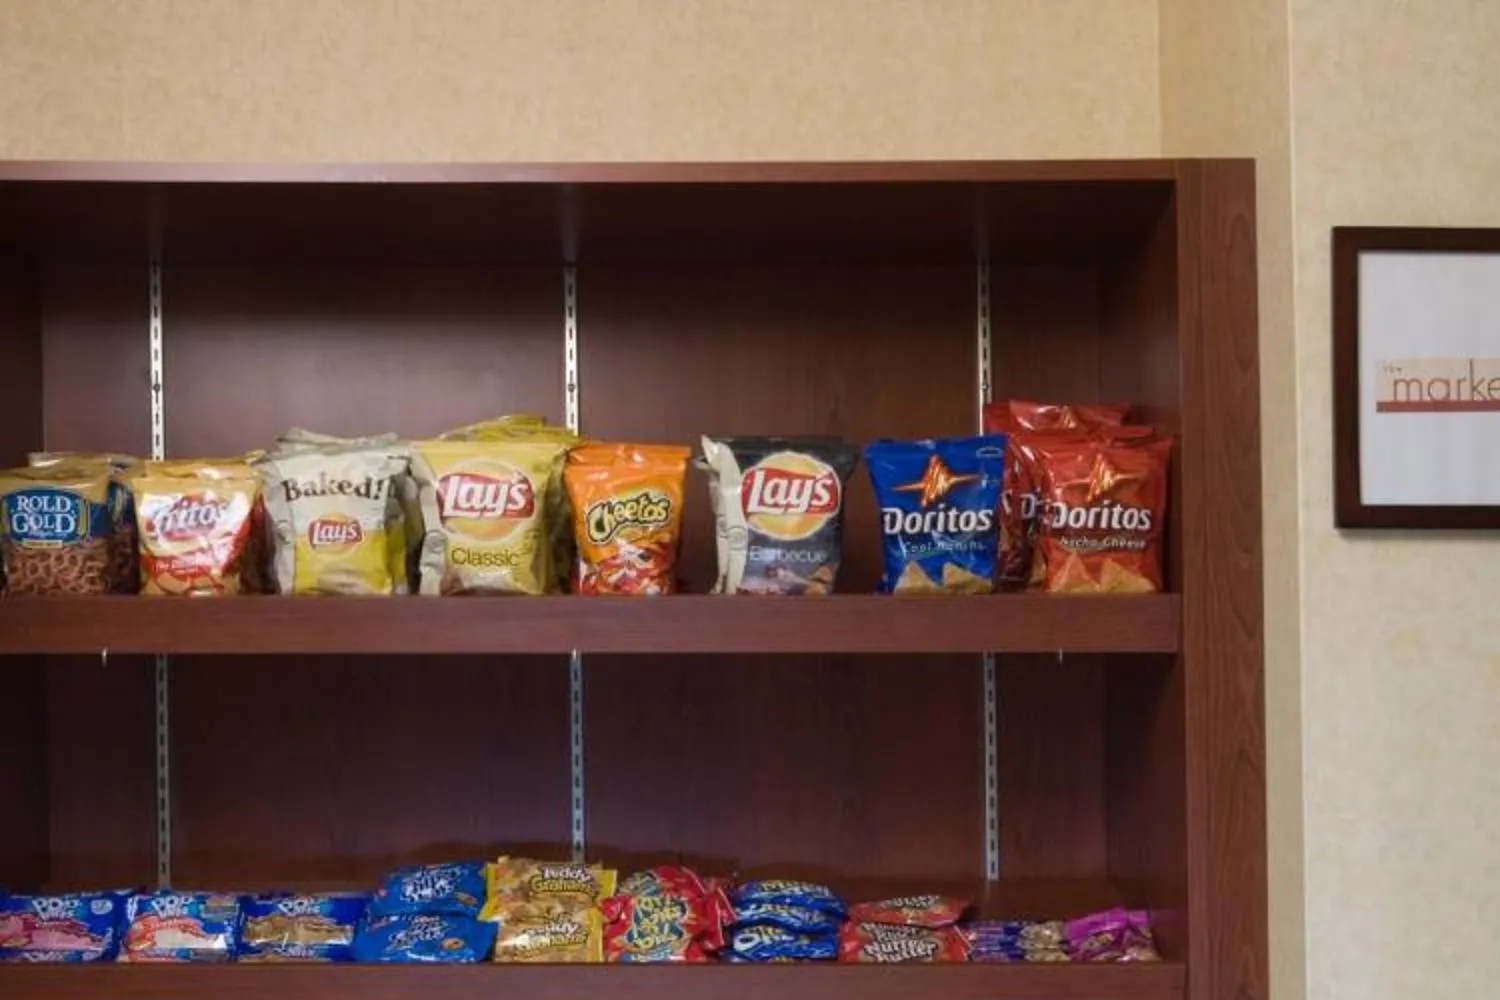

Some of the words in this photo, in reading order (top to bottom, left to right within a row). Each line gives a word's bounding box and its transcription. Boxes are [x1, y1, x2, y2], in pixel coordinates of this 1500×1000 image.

[17, 495, 72, 513] ROLD
[1047, 500, 1153, 531] Doritos
[12, 512, 76, 533] GOLD
[588, 495, 671, 542] Cheetos
[881, 504, 993, 535] Doritos
[451, 548, 521, 567] Classic
